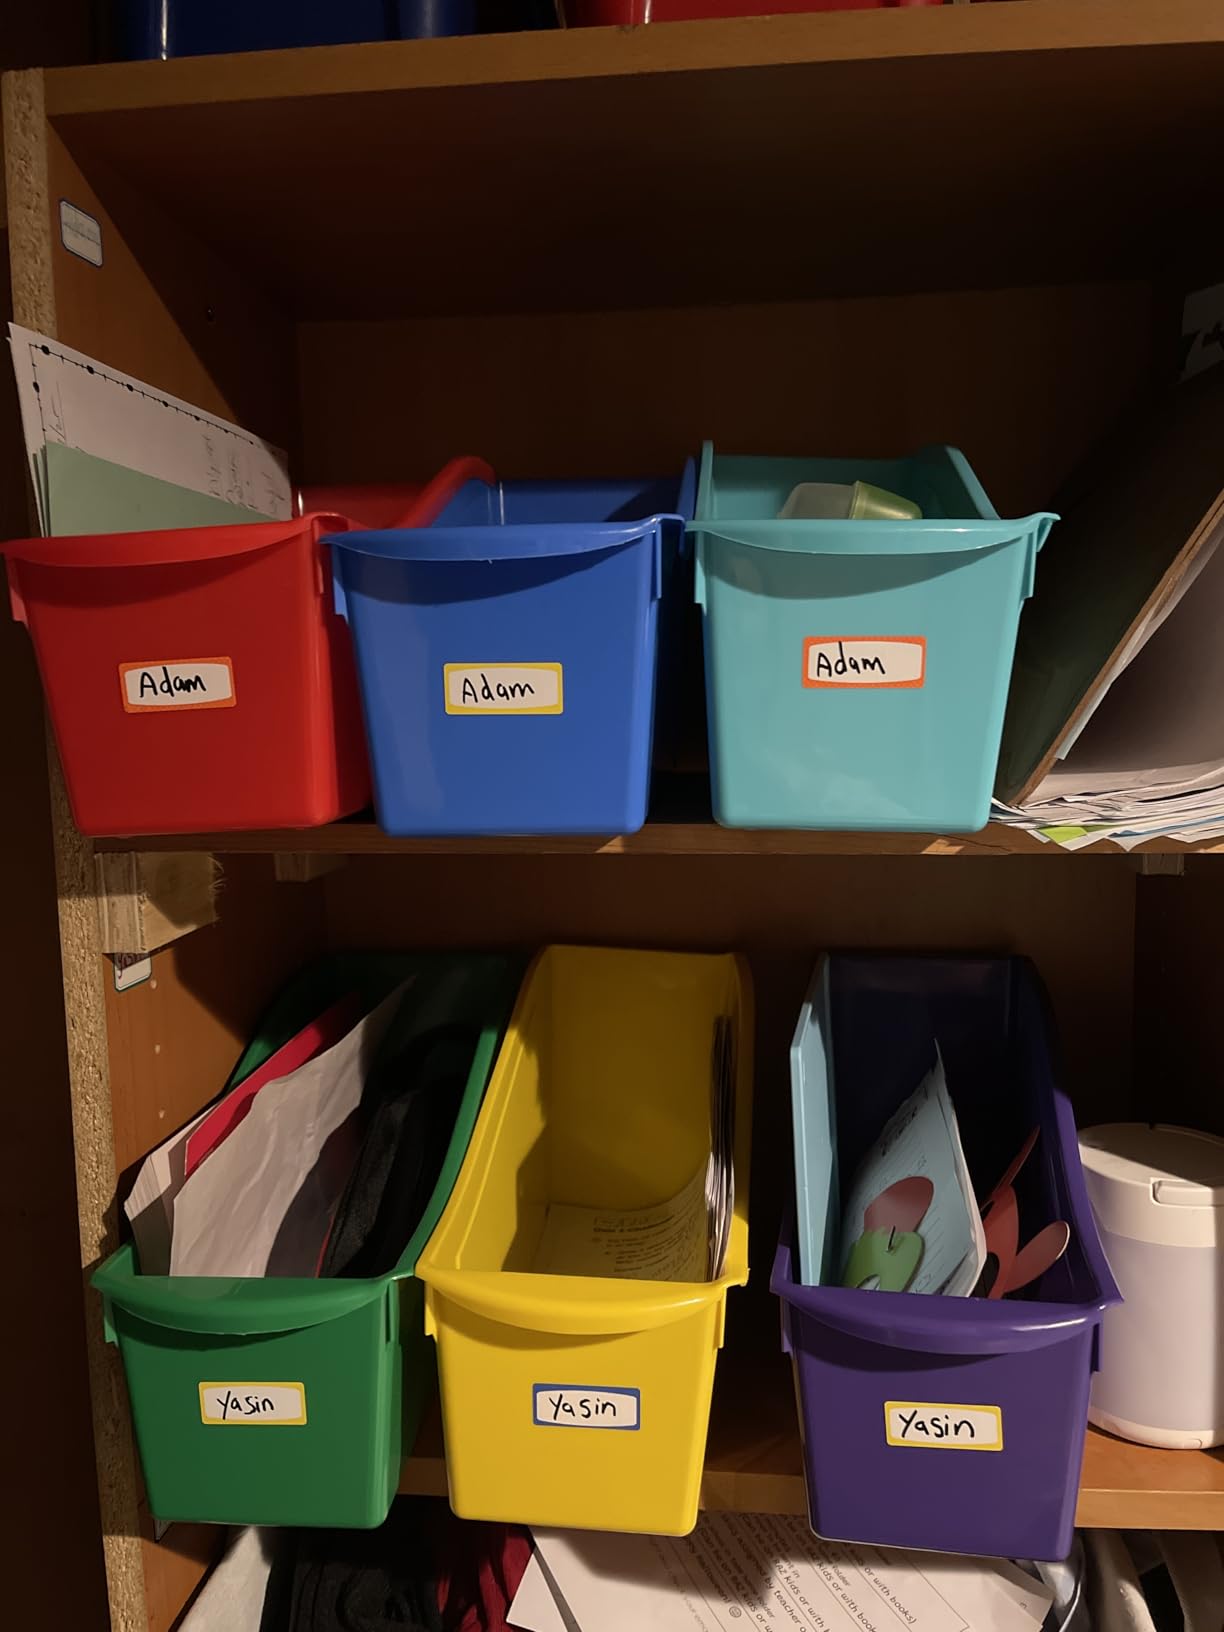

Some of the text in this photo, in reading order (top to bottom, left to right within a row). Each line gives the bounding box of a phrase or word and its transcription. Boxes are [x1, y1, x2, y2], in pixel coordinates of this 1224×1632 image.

[817, 641, 886, 677] Adam
[139, 666, 208, 698] Adam
[462, 673, 535, 704] Adam
[217, 1391, 275, 1420] Yasin
[549, 1394, 616, 1420] Yasin
[898, 1409, 975, 1438] Yasin
[773, 1589, 803, 1624] teacher
[784, 1575, 802, 1596] kids
[798, 1596, 810, 1606] or
[807, 1607, 825, 1628] with
[832, 1582, 843, 1592] or
[840, 1592, 858, 1613] with
[864, 1567, 875, 1578] or
[873, 1575, 891, 1597] with
[890, 1593, 917, 1625] books)
[755, 1614, 767, 1624] or
